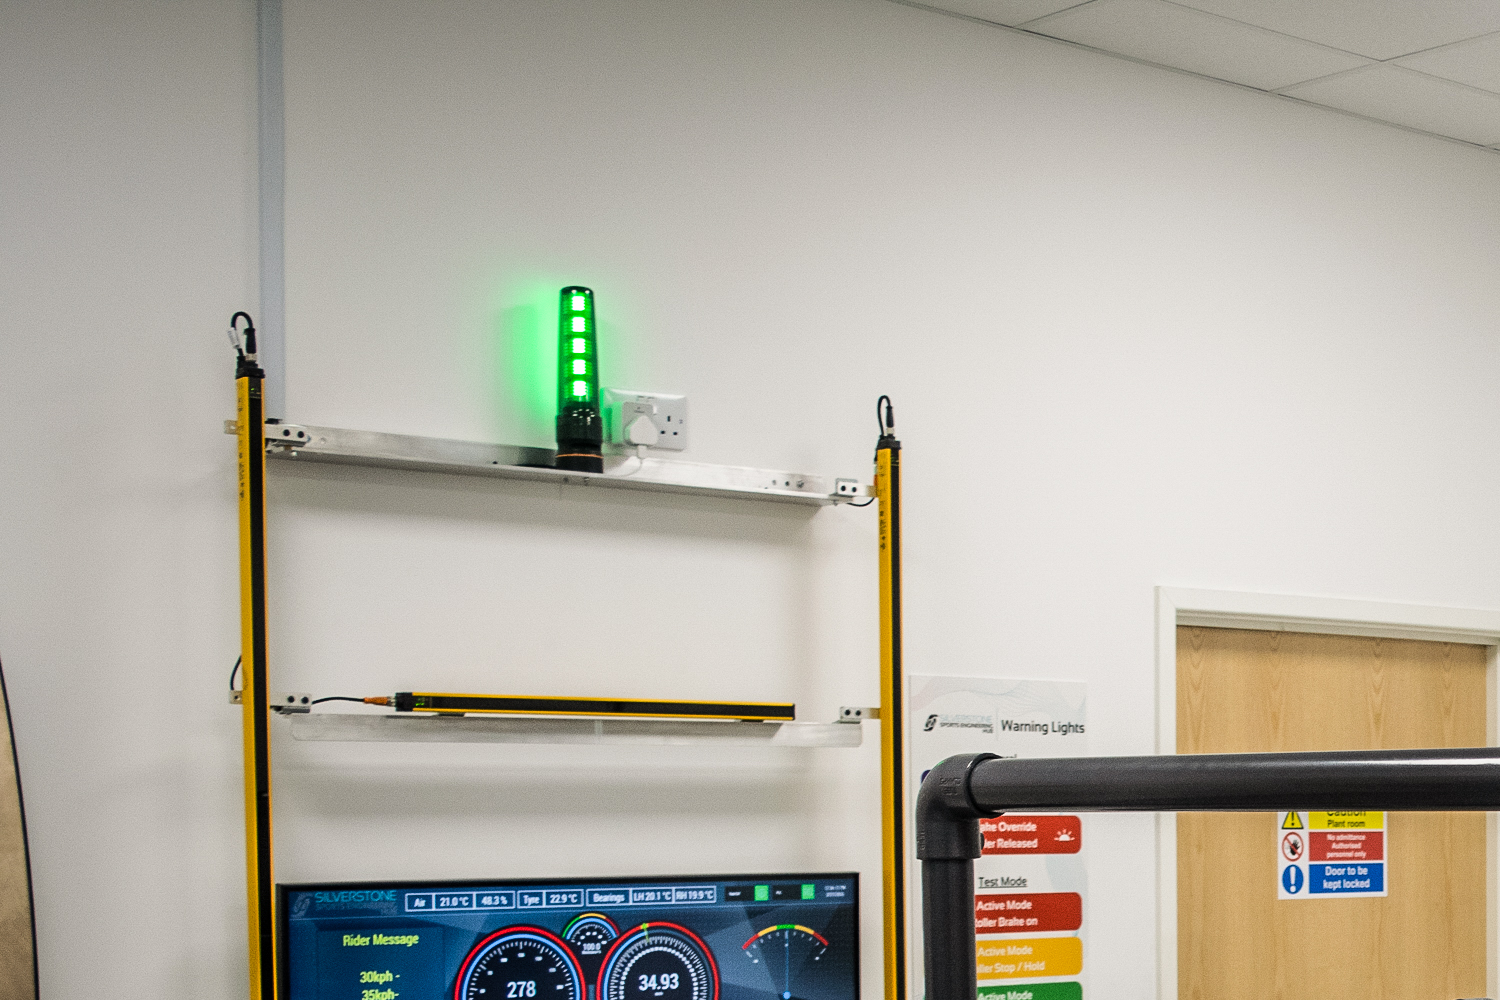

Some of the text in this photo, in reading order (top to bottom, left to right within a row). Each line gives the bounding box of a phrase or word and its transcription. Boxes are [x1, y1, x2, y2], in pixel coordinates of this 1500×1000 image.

[1001, 720, 1085, 736] Warning Lights
[998, 822, 1037, 832] Override
[997, 838, 1038, 849] Released
[1325, 866, 1368, 876] Door to be
[978, 876, 1028, 887] Test Mode
[1323, 878, 1370, 891] kept locked
[314, 890, 397, 903] SILVERSTONE
[414, 897, 426, 908] Air
[523, 895, 540, 905] Tyre
[593, 892, 626, 904] Bearings
[976, 900, 1033, 911] Active Mode
[998, 917, 1025, 927] Brake
[1026, 918, 1039, 926] on
[342, 934, 420, 947] Rider Message
[978, 945, 1033, 957] Active Mode
[994, 962, 1016, 974] Stop
[1024, 960, 1046, 971] Hold
[359, 970, 394, 985] 30kph
[638, 973, 680, 991] 34.93
[506, 981, 537, 999] 278
[1007, 991, 1033, 1000] Mode
